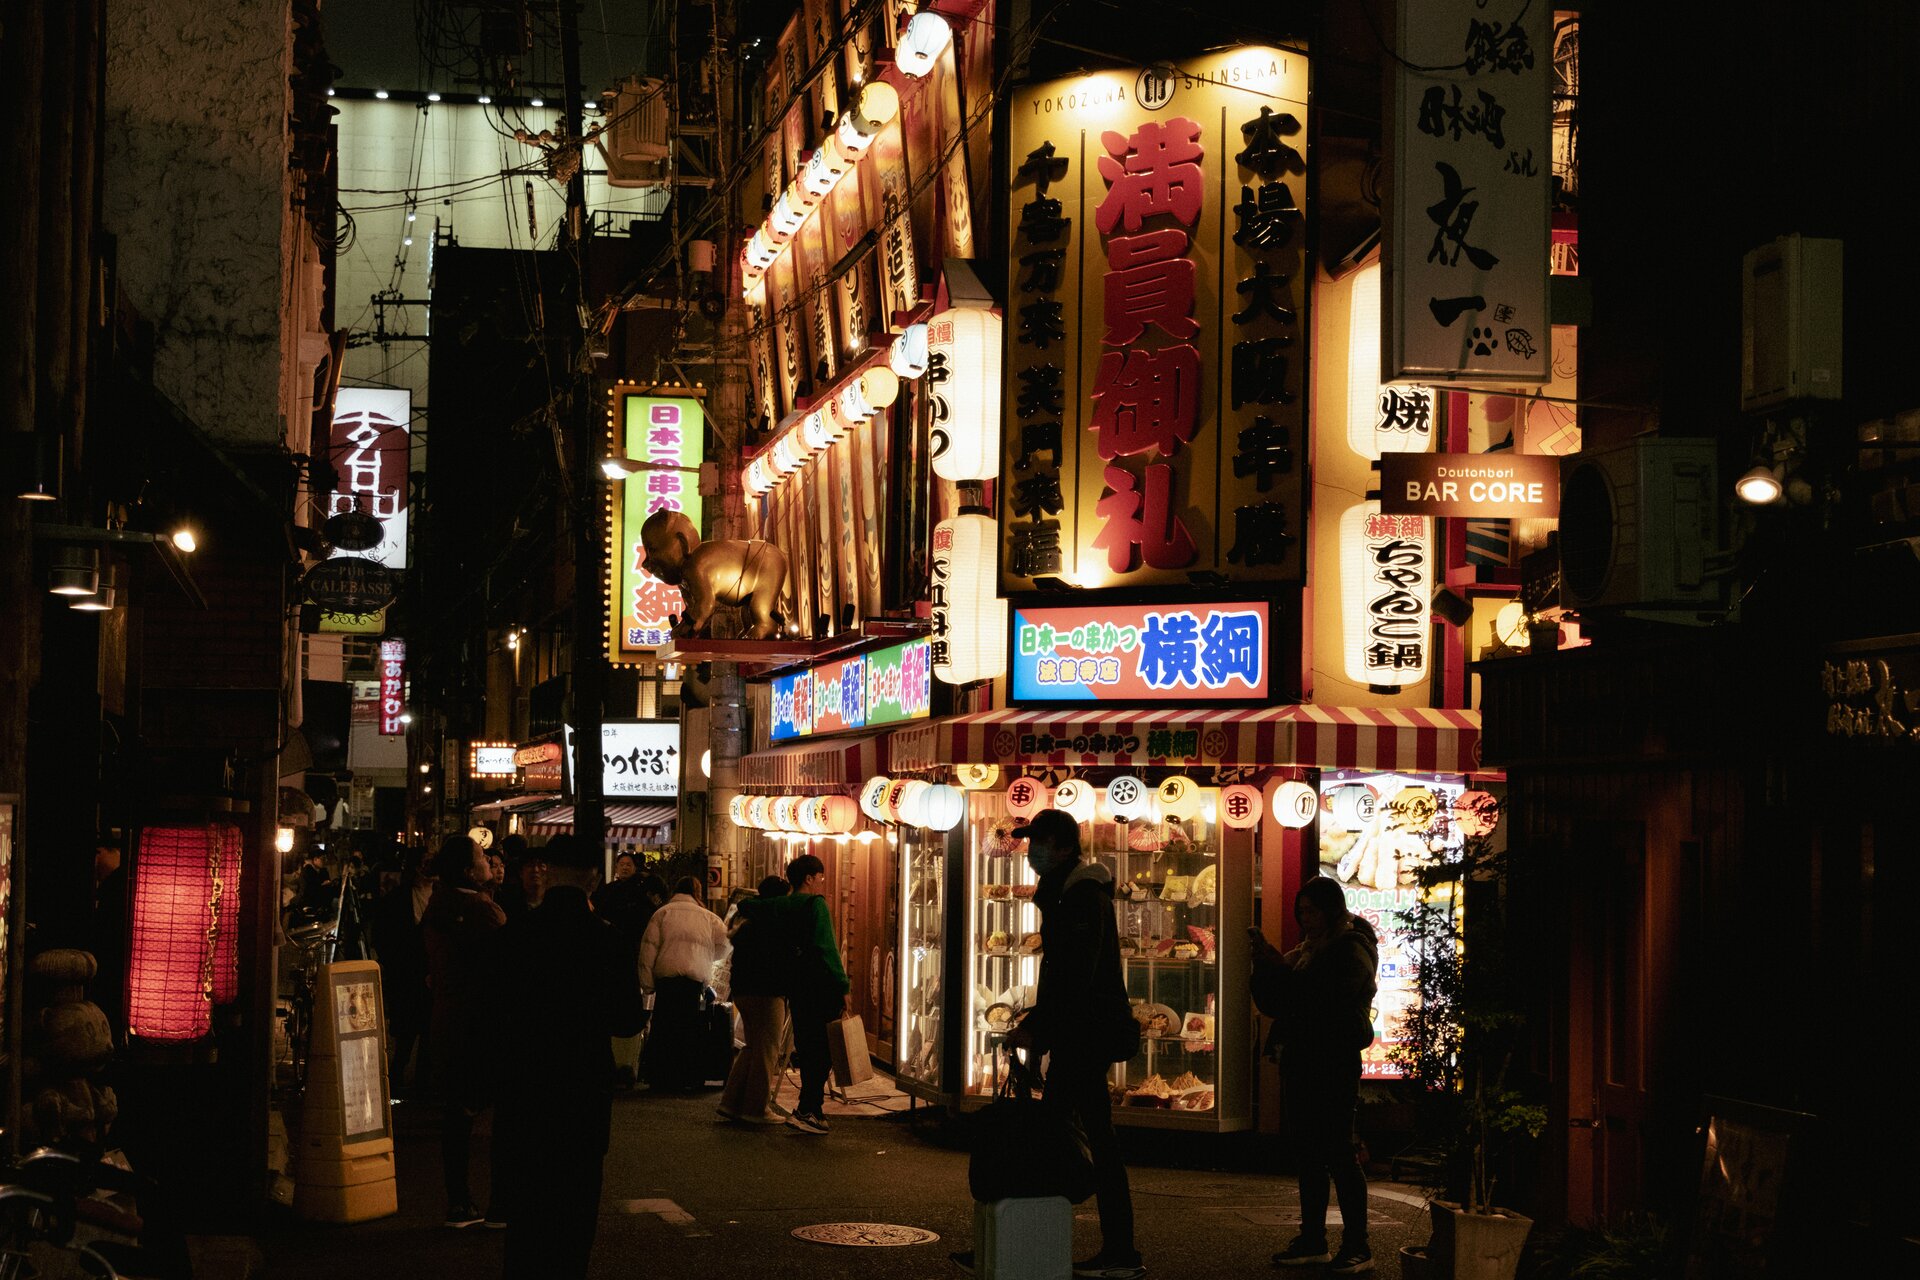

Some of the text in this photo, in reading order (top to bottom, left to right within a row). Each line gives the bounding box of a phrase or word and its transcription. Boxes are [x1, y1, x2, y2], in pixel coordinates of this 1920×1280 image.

[1089, 116, 1204, 574] 満員御礼
[1438, 467, 1514, 478] Doutonbori
[1407, 482, 1543, 503] BAR CORE
[310, 580, 392, 595] CALEBASSE
[1368, 540, 1424, 669] ちゃんこ鍋
[1021, 625, 1138, 654] 日本一の串かつ
[1139, 613, 1259, 686] 横綱
[1020, 734, 1141, 755] 日本一の串かつ
[1013, 783, 1030, 805] 串
[1229, 795, 1249, 818] 串
